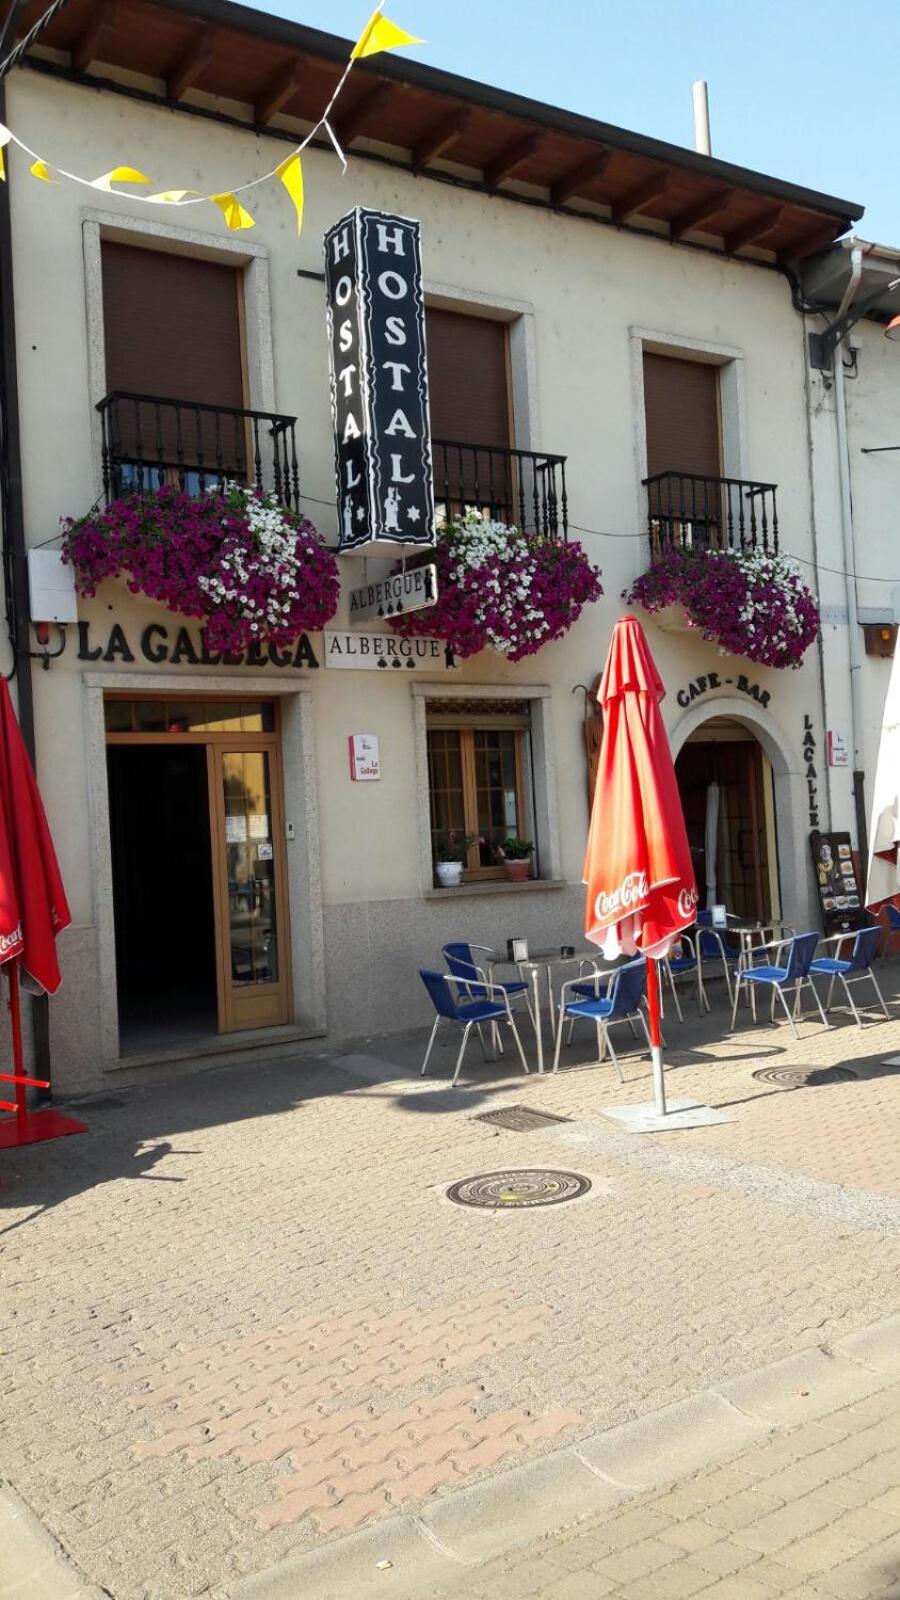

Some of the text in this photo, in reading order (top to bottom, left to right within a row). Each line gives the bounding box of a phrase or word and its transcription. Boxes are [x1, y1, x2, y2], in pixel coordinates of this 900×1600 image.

[332, 228, 362, 489] HOSTAL
[376, 222, 418, 485] HOSTAL
[350, 571, 423, 612] ALBERGUE
[77, 621, 135, 662] LA
[329, 635, 440, 658] ALBERGUE
